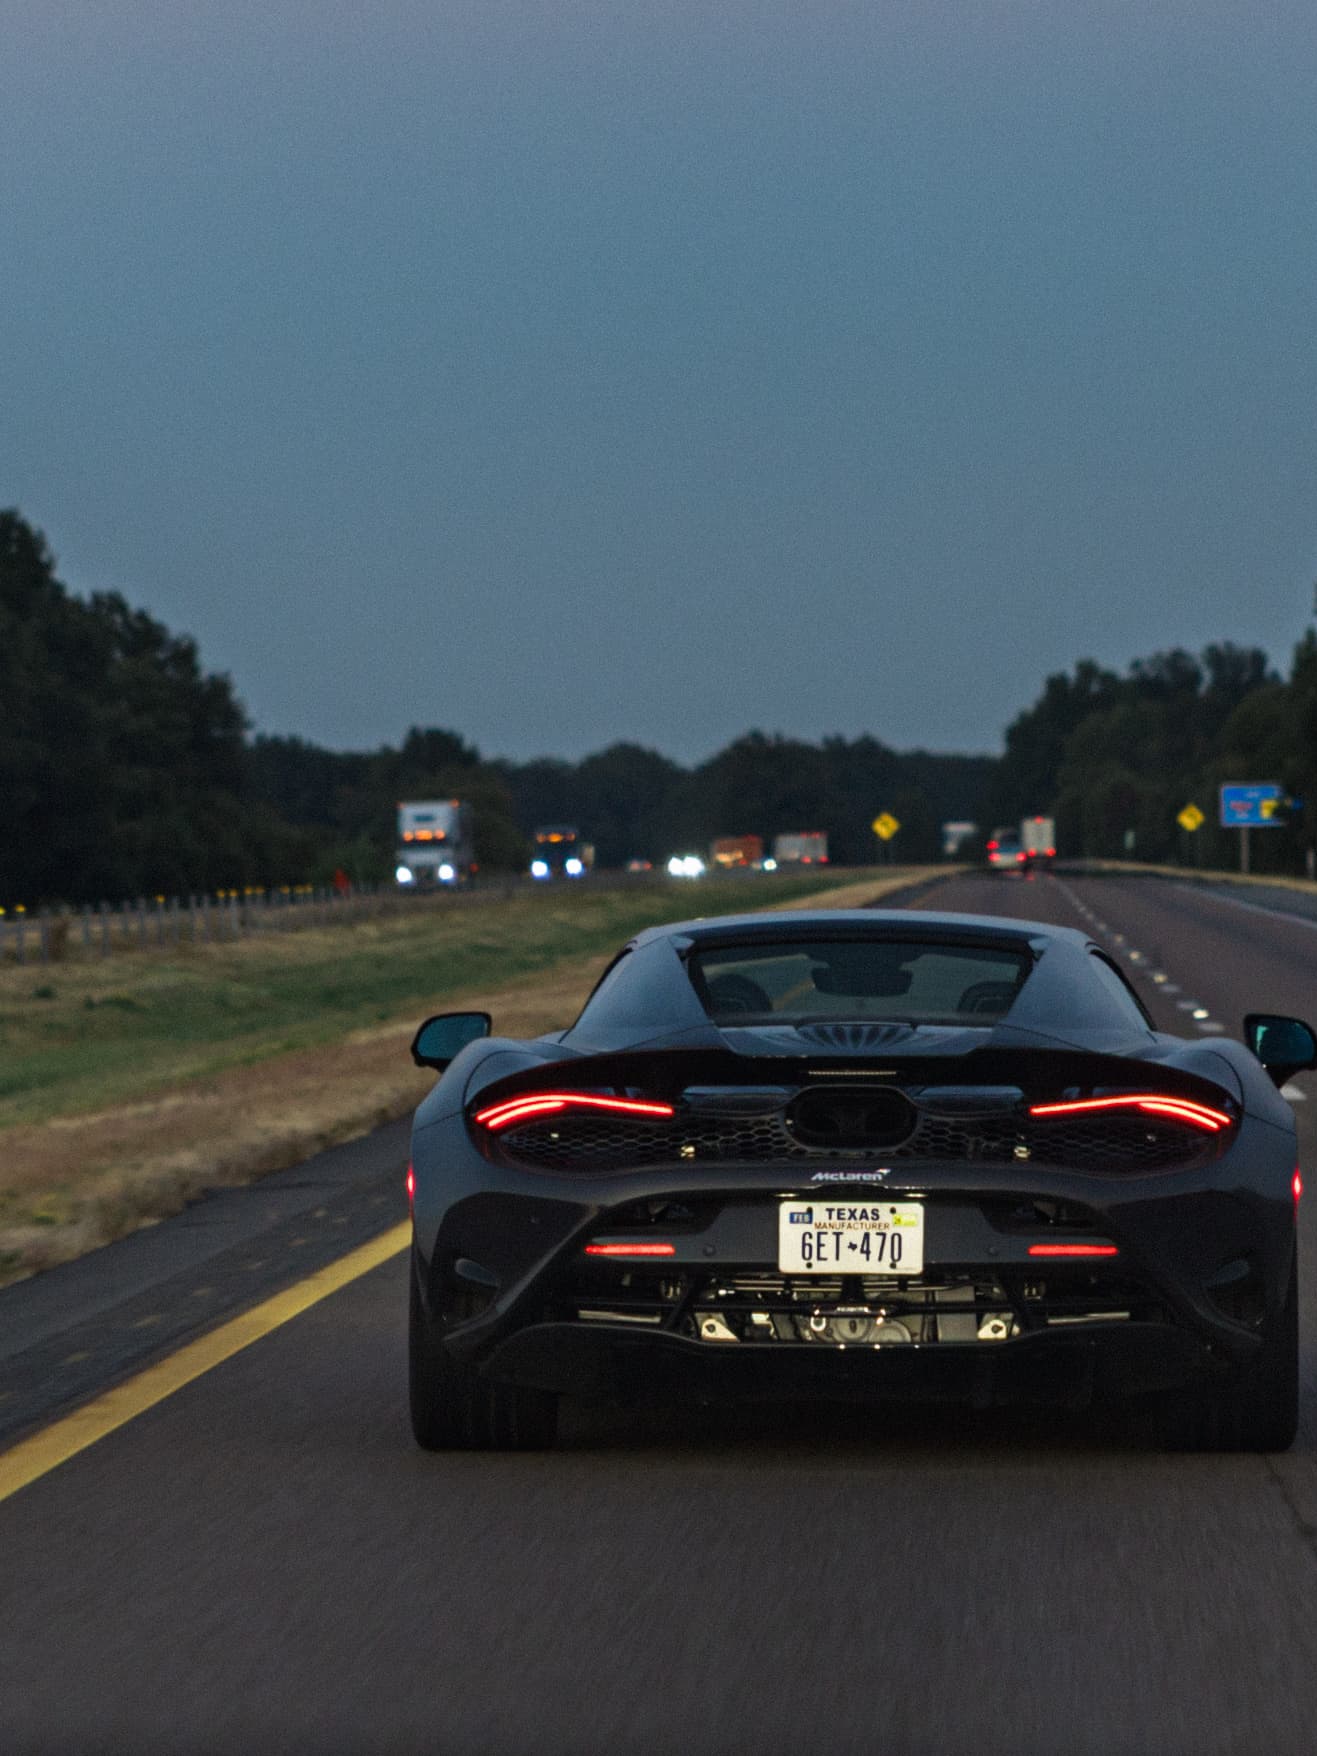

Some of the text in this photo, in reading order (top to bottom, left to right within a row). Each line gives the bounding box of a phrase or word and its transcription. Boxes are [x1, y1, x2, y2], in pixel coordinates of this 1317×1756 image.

[811, 1172, 883, 1181] McLaren
[825, 1208, 880, 1221] TEXAS
[814, 1222, 890, 1231] MANUFACTURER
